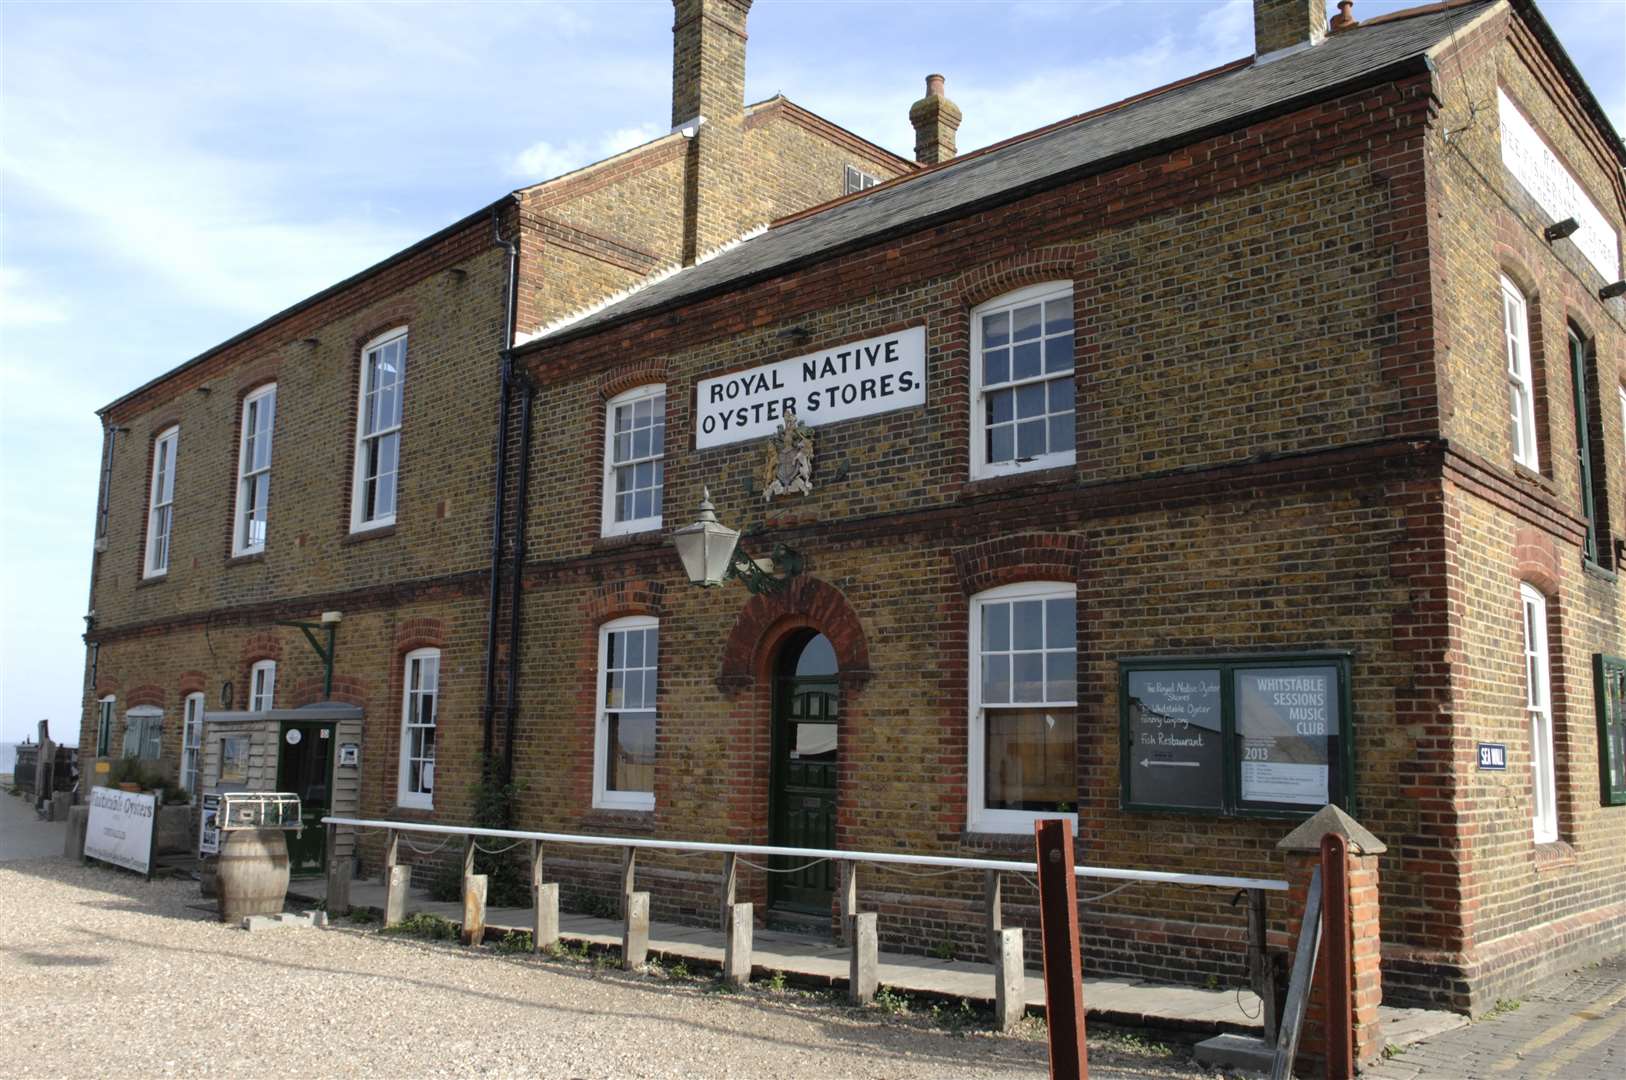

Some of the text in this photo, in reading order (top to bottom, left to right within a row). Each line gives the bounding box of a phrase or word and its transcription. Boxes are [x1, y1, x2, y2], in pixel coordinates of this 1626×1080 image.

[711, 340, 899, 404] ROYAL NATIVE
[702, 370, 920, 434] OYSTER STORES.
[1257, 678, 1324, 692] WHITSTABLE
[1273, 693, 1324, 706] SESSIONS
[1289, 707, 1325, 721] MUSIC
[1296, 722, 1325, 736] CLUB
[1141, 732, 1205, 747] Fish Restaurant
[1244, 747, 1269, 761] 2013
